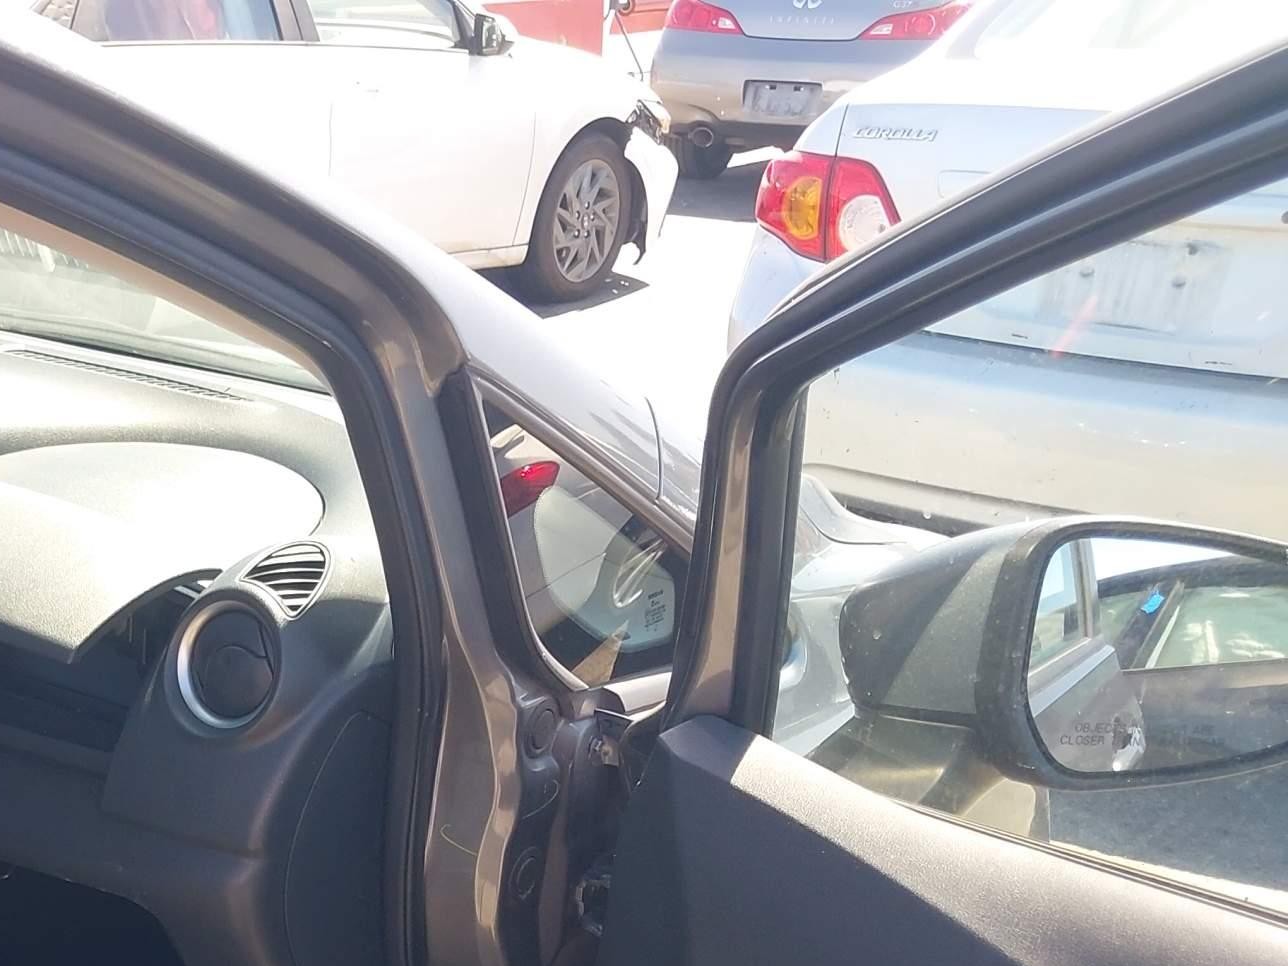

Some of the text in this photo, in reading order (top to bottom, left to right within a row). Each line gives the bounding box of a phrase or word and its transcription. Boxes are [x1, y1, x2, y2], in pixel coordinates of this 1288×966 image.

[853, 127, 938, 142] COROLLA
[1074, 722, 1128, 734] OBJECTS
[1059, 734, 1106, 746] CLOSER
